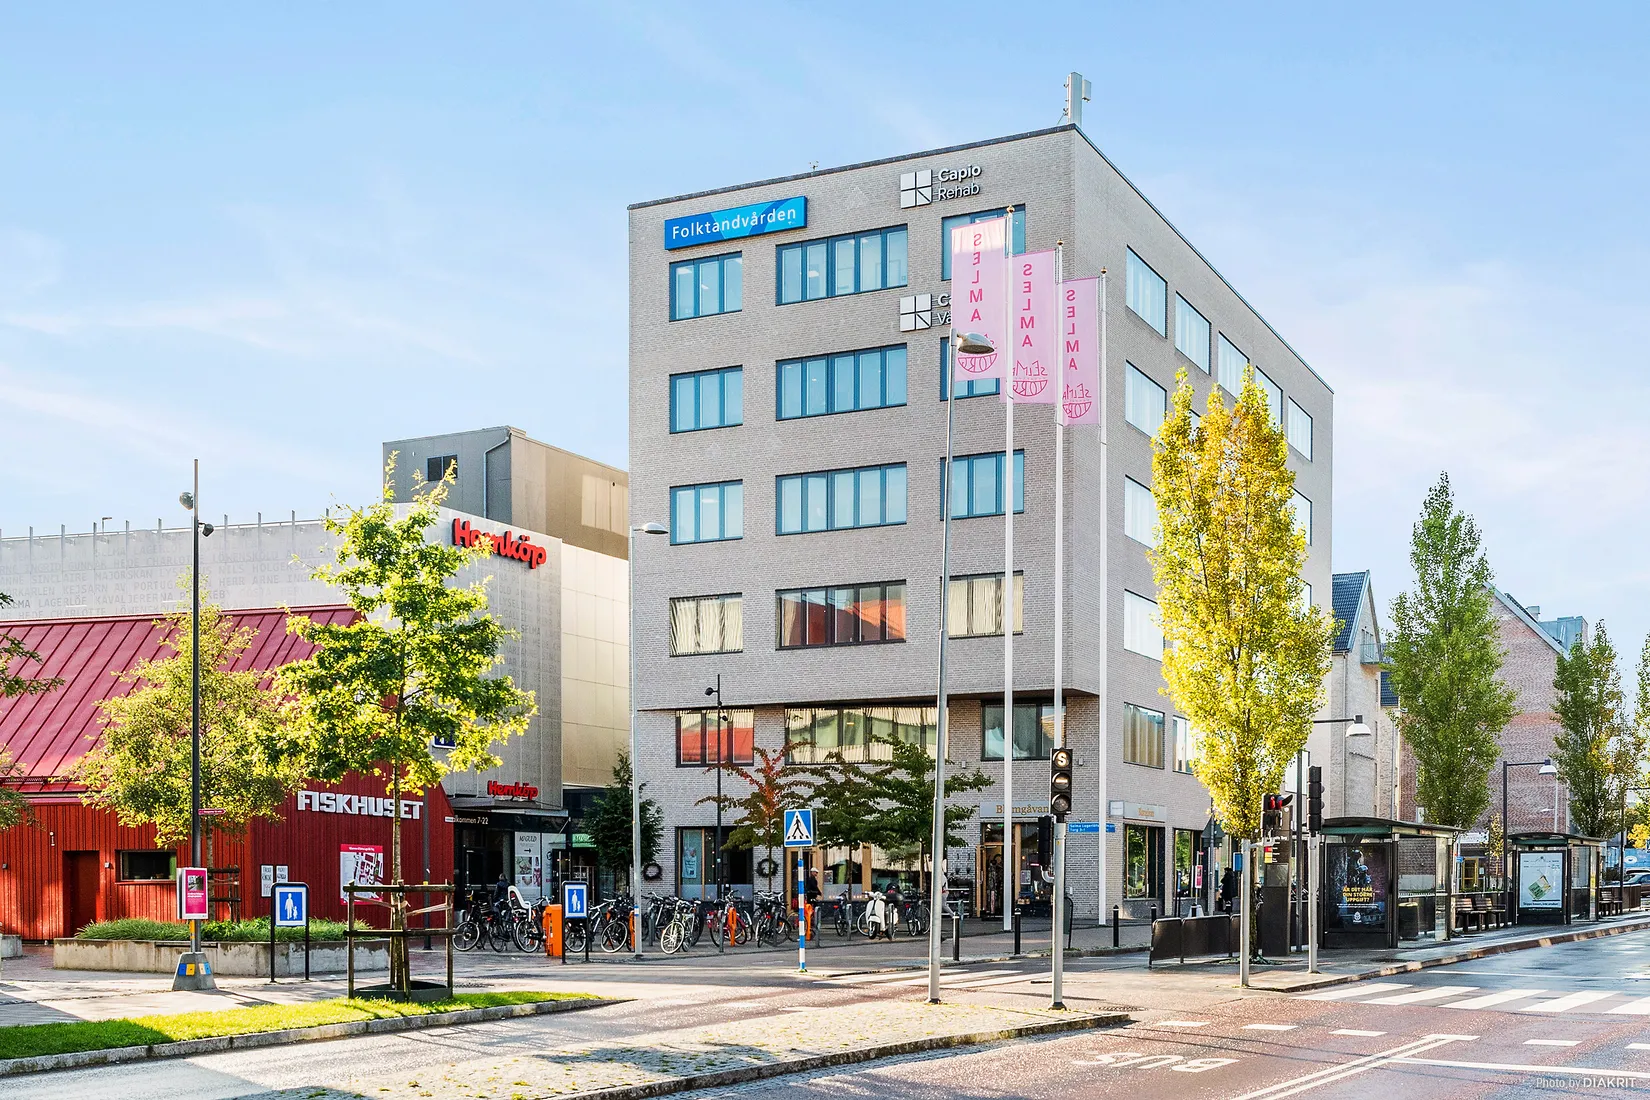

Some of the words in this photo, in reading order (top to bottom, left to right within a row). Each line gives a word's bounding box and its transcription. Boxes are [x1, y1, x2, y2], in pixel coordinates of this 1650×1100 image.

[939, 164, 982, 184] Capio
[939, 183, 980, 202] Rehab
[672, 207, 797, 240] Folktandvården
[487, 780, 539, 800] Hemköp
[297, 789, 424, 820] FISKHUSET
[996, 803, 1049, 816] Blmgåvan
[477, 816, 489, 825] 7-22
